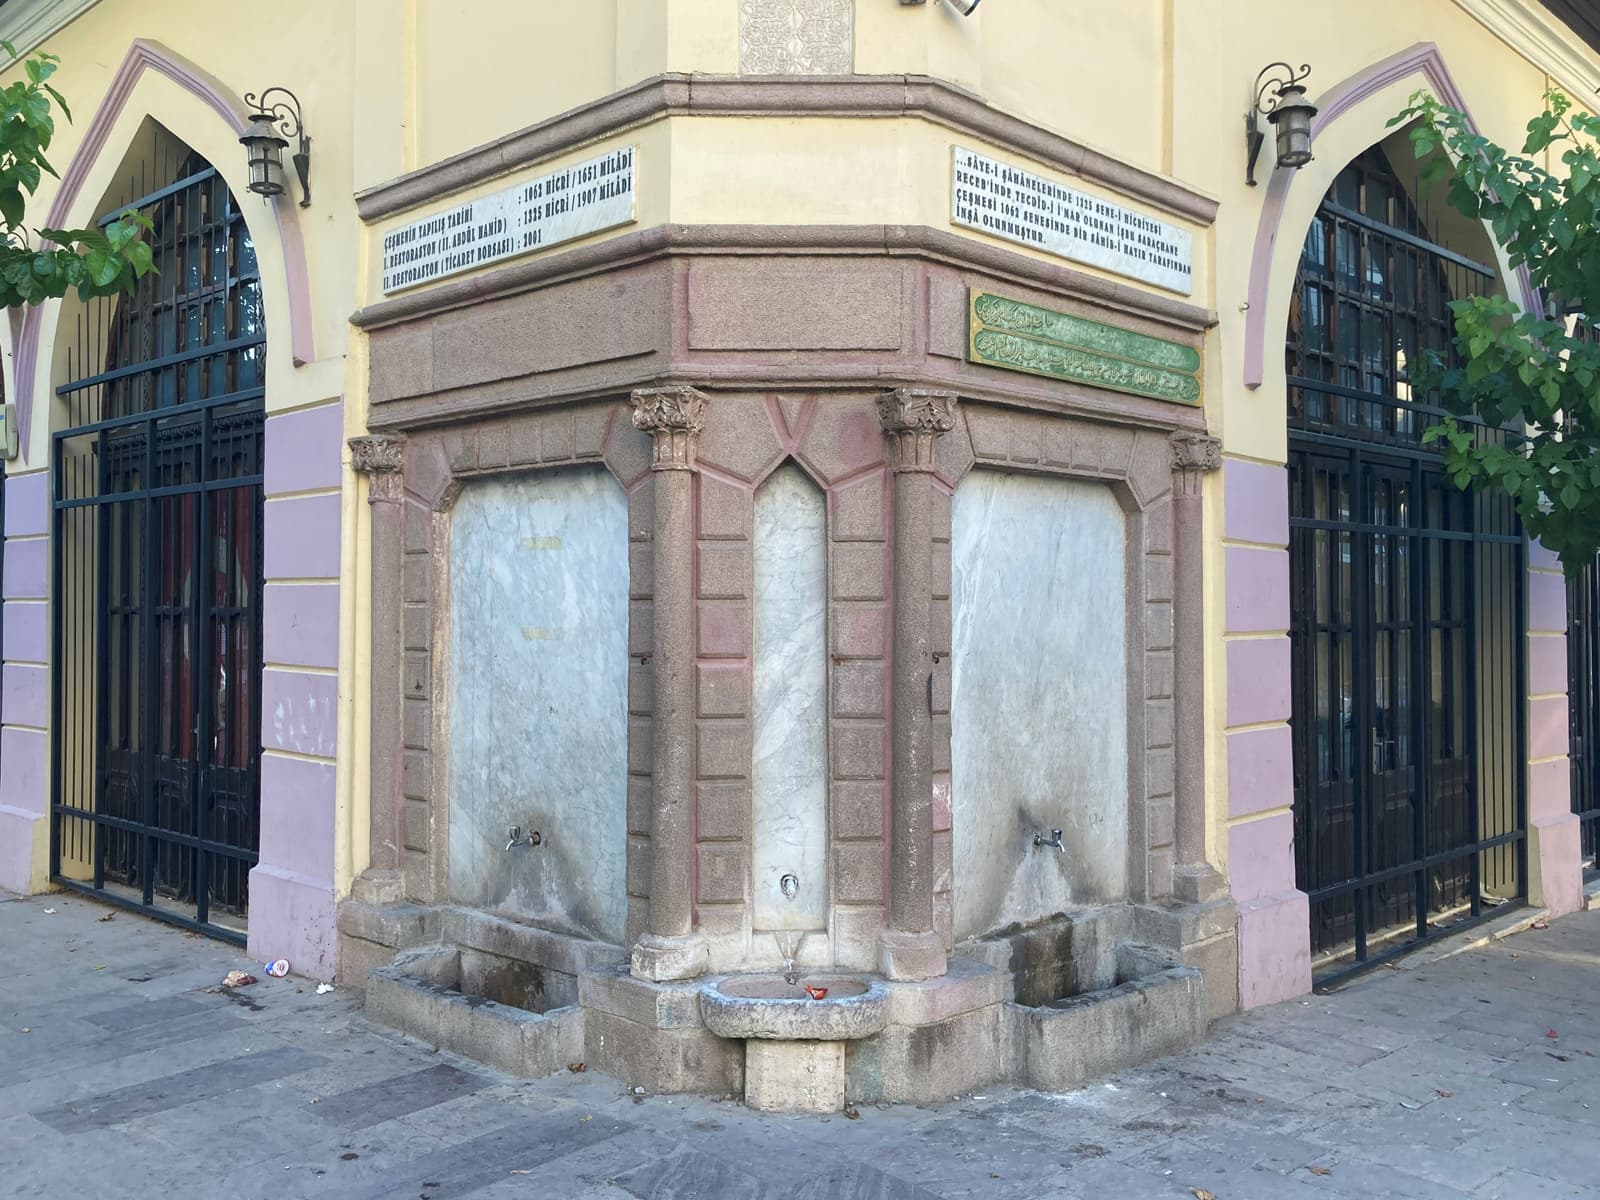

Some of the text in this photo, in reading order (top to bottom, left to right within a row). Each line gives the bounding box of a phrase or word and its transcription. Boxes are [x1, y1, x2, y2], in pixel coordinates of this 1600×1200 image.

[390, 242, 436, 268] RESTORASYON
[524, 206, 542, 224] 1325
[546, 193, 568, 218] HİCRİ
[578, 188, 596, 208] 1907
[419, 218, 445, 238] YAPILIŞ
[448, 204, 472, 228] TARİHİ
[524, 184, 542, 202] 1062
[546, 170, 570, 195] HİCRİ
[578, 165, 596, 184] 1651
[956, 188, 996, 211] ÇEŞMESİ
[1001, 202, 1020, 218] 1062
[1024, 210, 1070, 235] SENESİNDE
[1074, 227, 1087, 240] BİR
[1124, 244, 1146, 260] HAYIR
[1149, 253, 1190, 274] TARAFINDAN
[983, 214, 1046, 244] OLUNMUŞTUR.
[1084, 216, 1114, 234] OLUNAN
[392, 260, 438, 286] RESTORASYON
[524, 228, 541, 247] 2001
